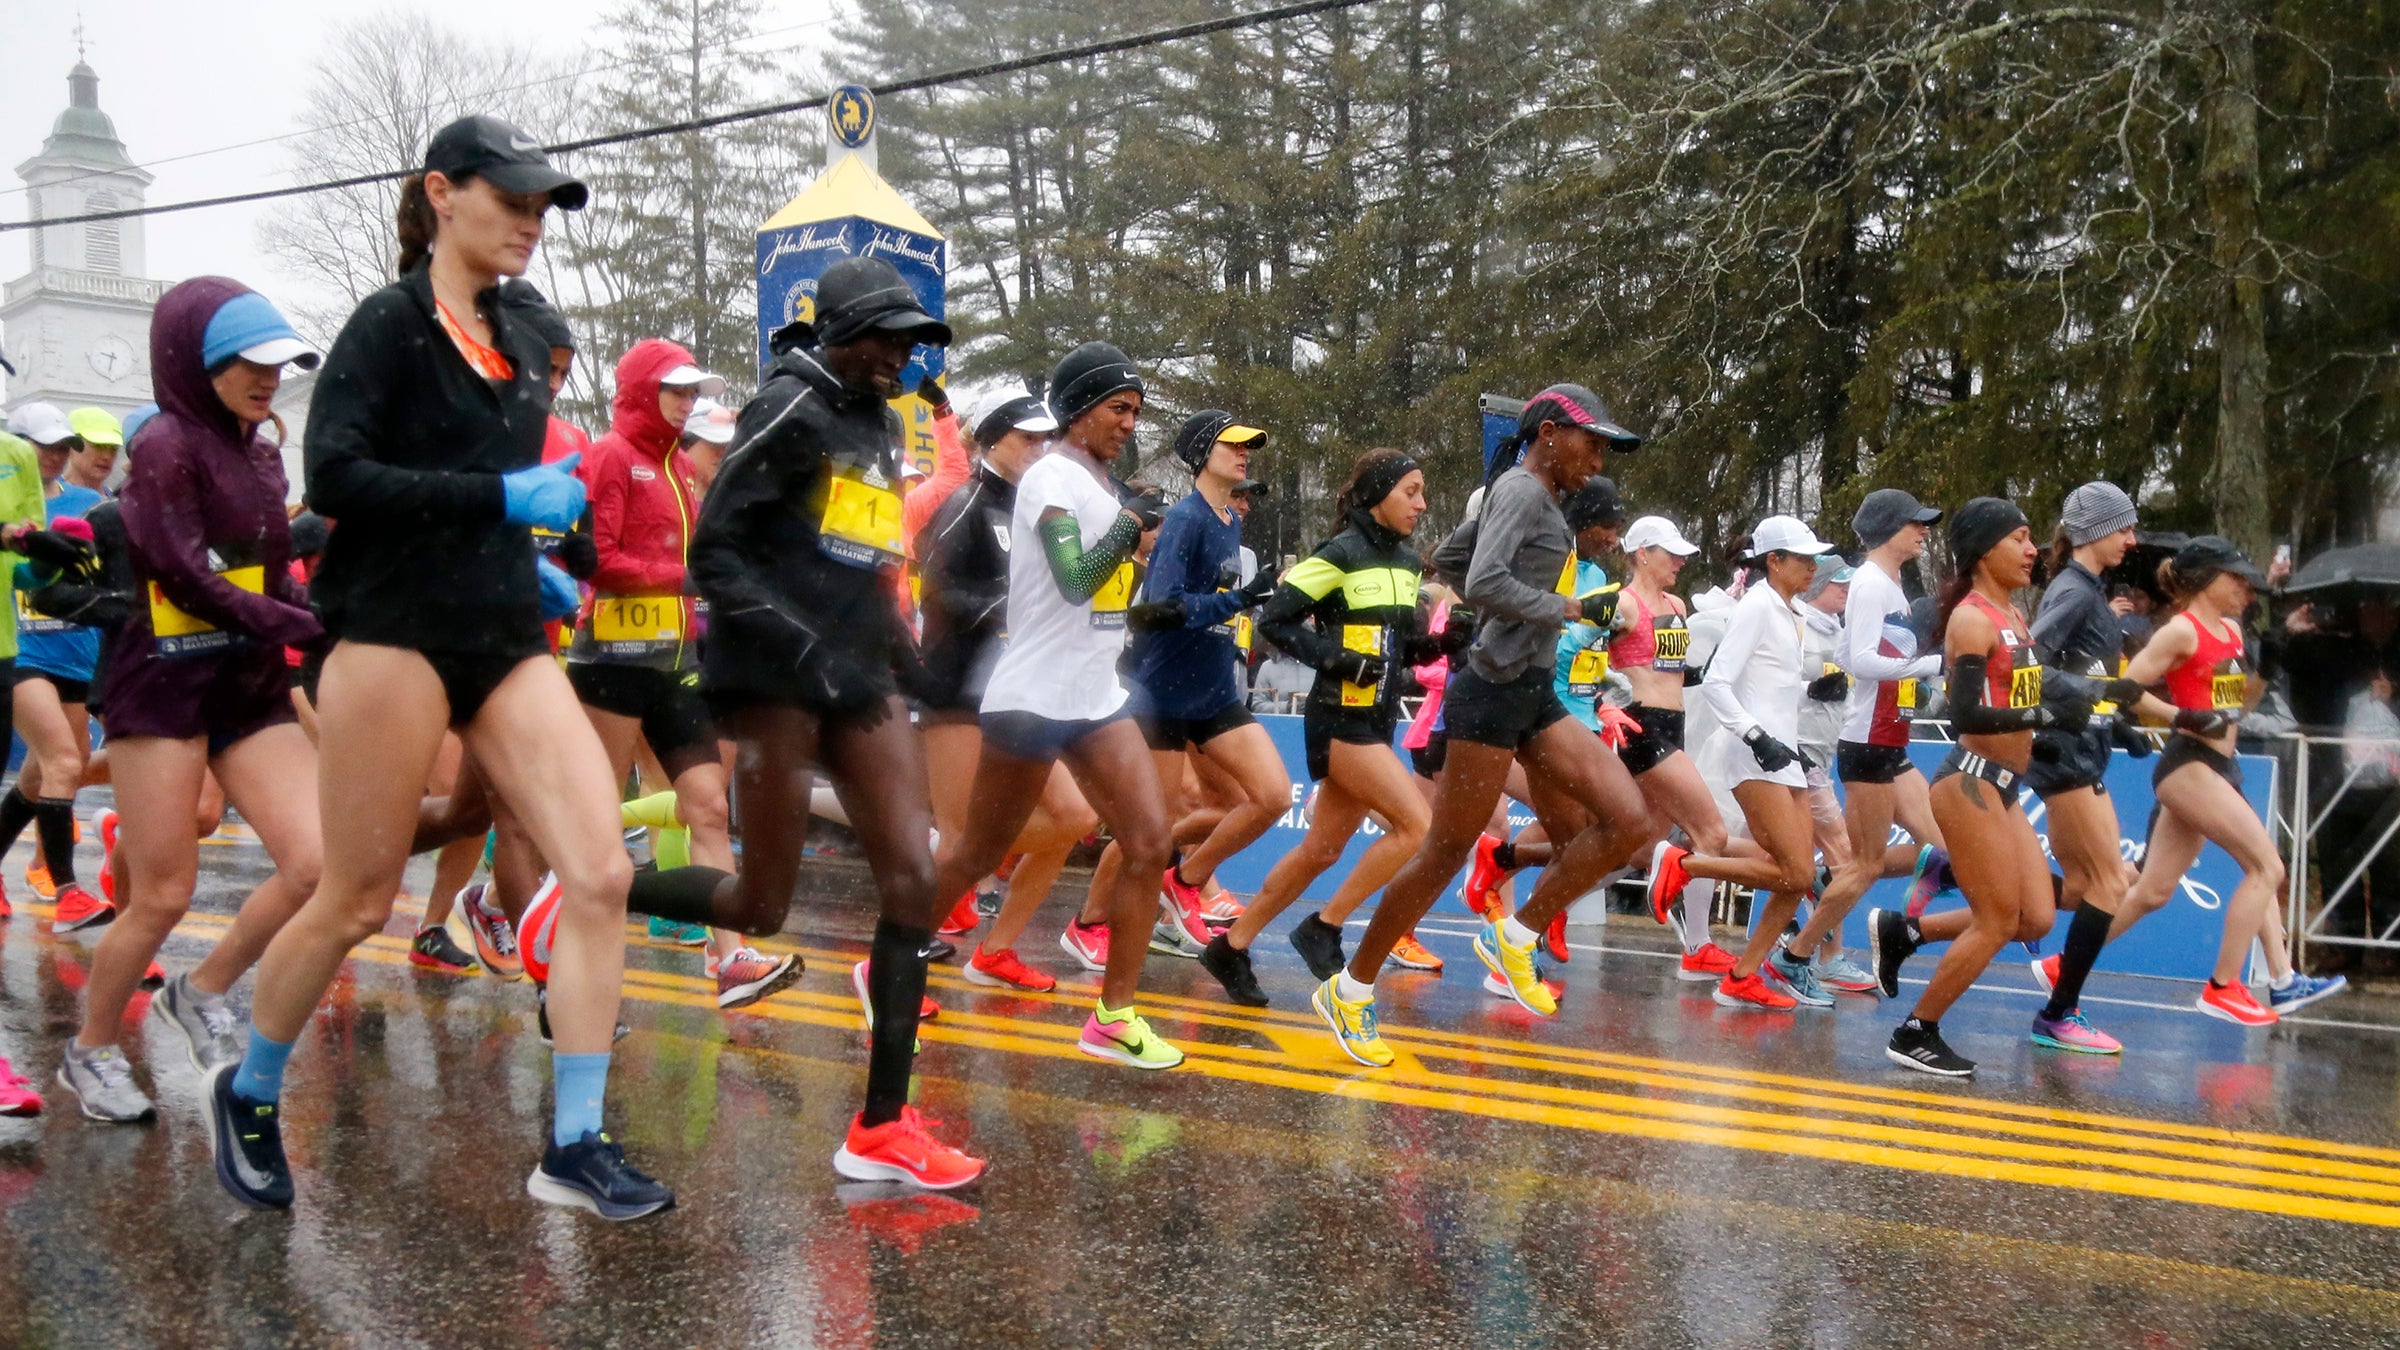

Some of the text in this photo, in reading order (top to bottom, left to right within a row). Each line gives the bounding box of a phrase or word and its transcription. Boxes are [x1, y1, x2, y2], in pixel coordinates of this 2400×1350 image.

[761, 224, 850, 274] John Hancock
[859, 224, 942, 276] John Hancock
[866, 496, 878, 529] 1
[614, 603, 661, 628] 101
